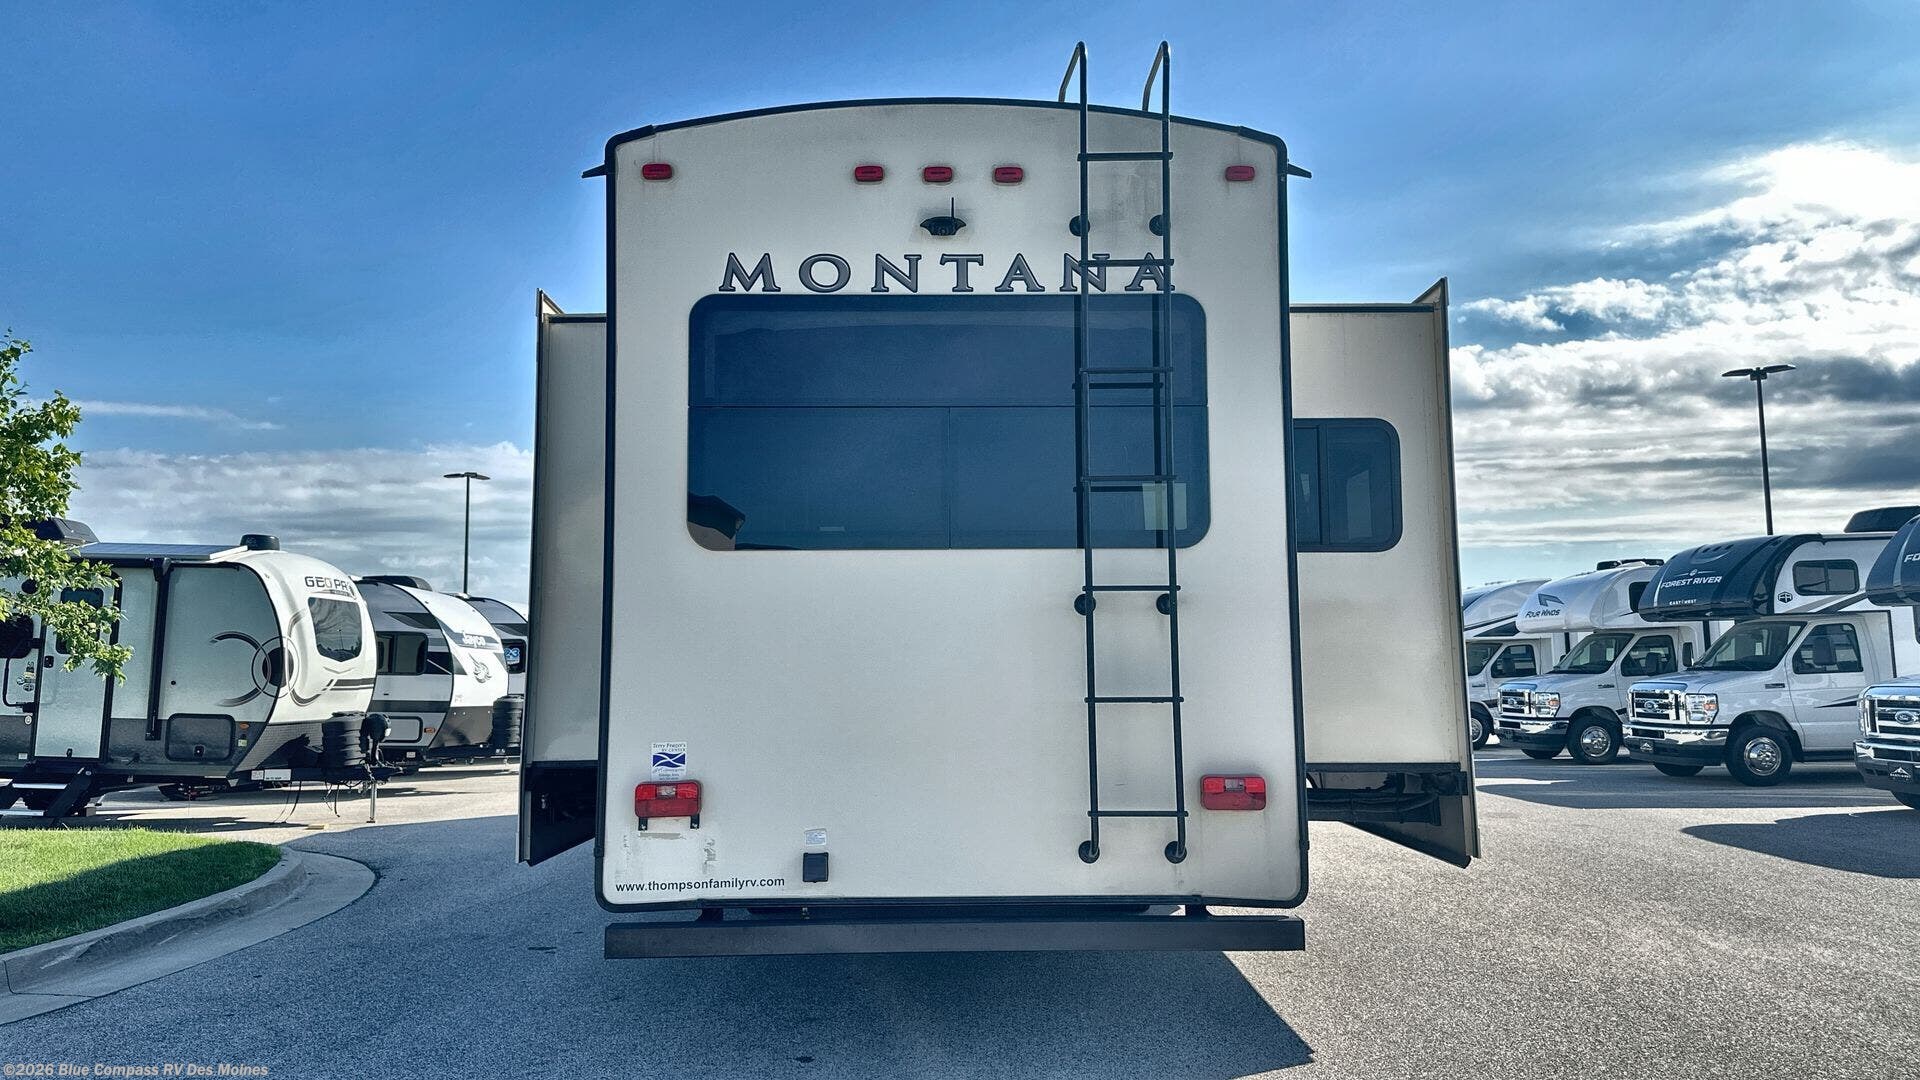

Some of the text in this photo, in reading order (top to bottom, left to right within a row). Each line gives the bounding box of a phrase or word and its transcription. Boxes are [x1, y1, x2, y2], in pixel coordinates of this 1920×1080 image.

[718, 252, 1176, 293] MONTANA
[305, 576, 332, 588] GEO
[1661, 576, 1722, 588] FOREST RIVER
[462, 630, 486, 648] Jayco
[615, 877, 785, 892] www.thompsonfamilyrv.com
